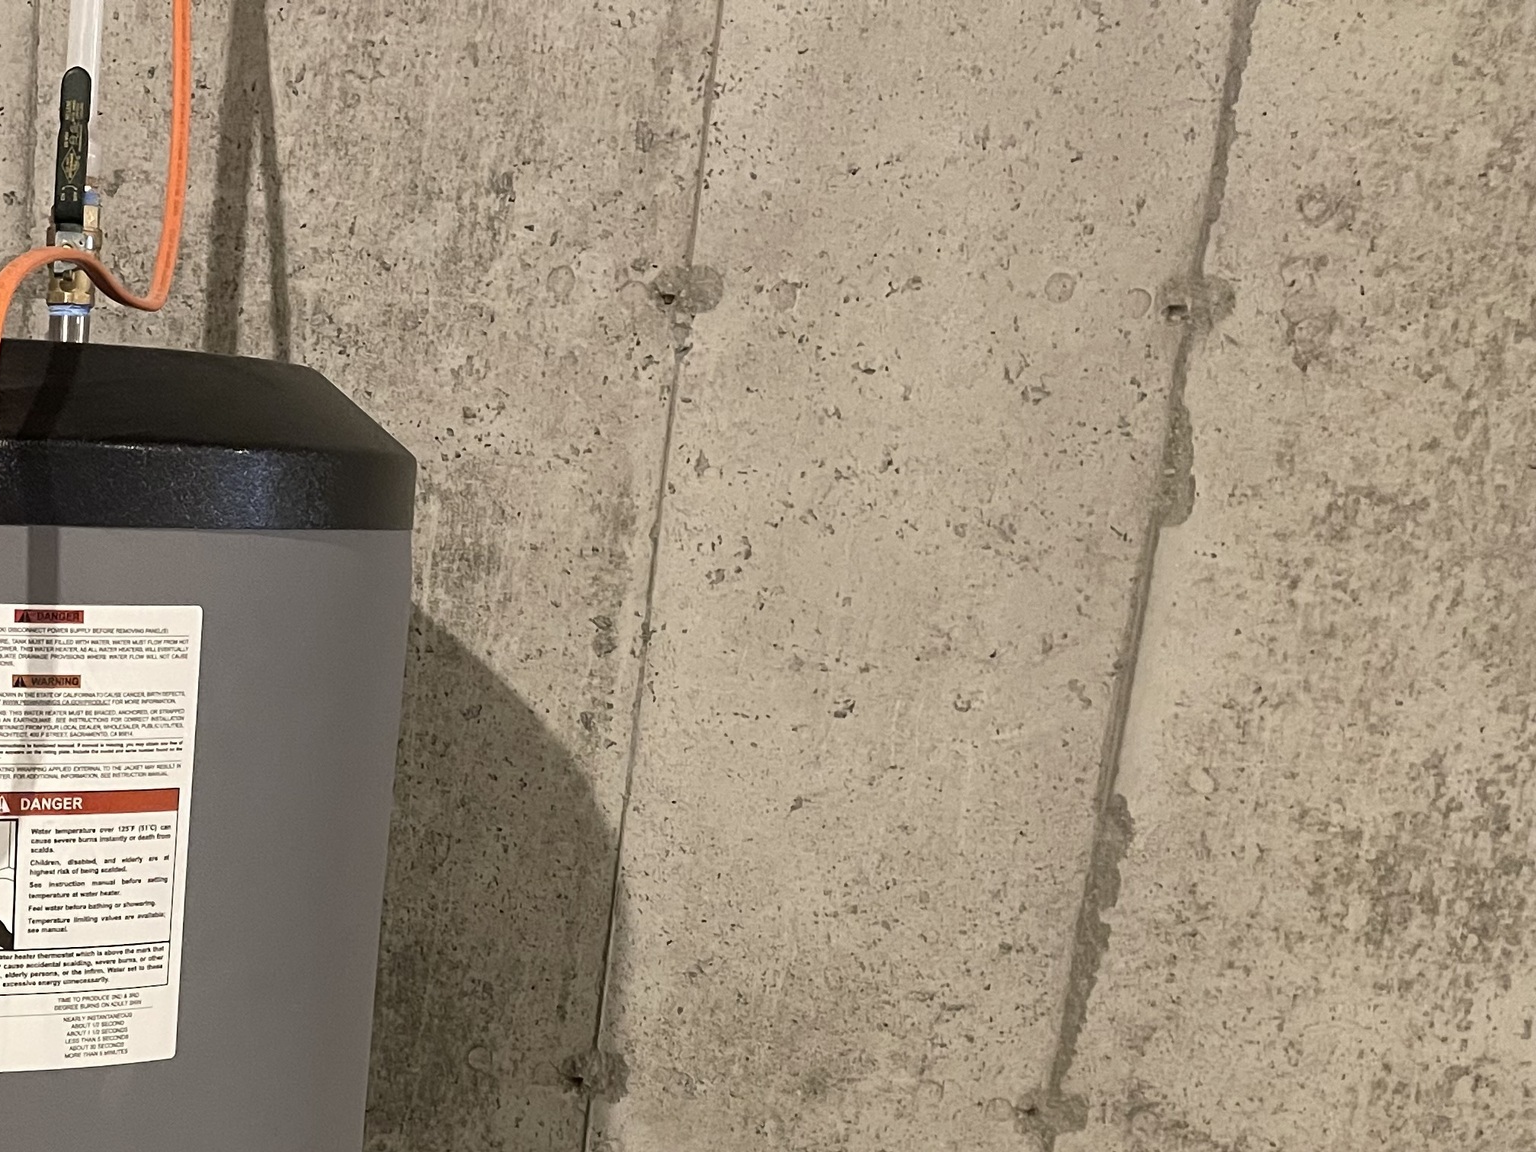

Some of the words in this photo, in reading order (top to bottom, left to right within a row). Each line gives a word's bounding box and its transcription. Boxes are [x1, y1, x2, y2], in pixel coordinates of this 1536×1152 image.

[36, 611, 81, 622] DANGER
[31, 677, 80, 687] WARNING
[20, 798, 83, 811] DANGER
